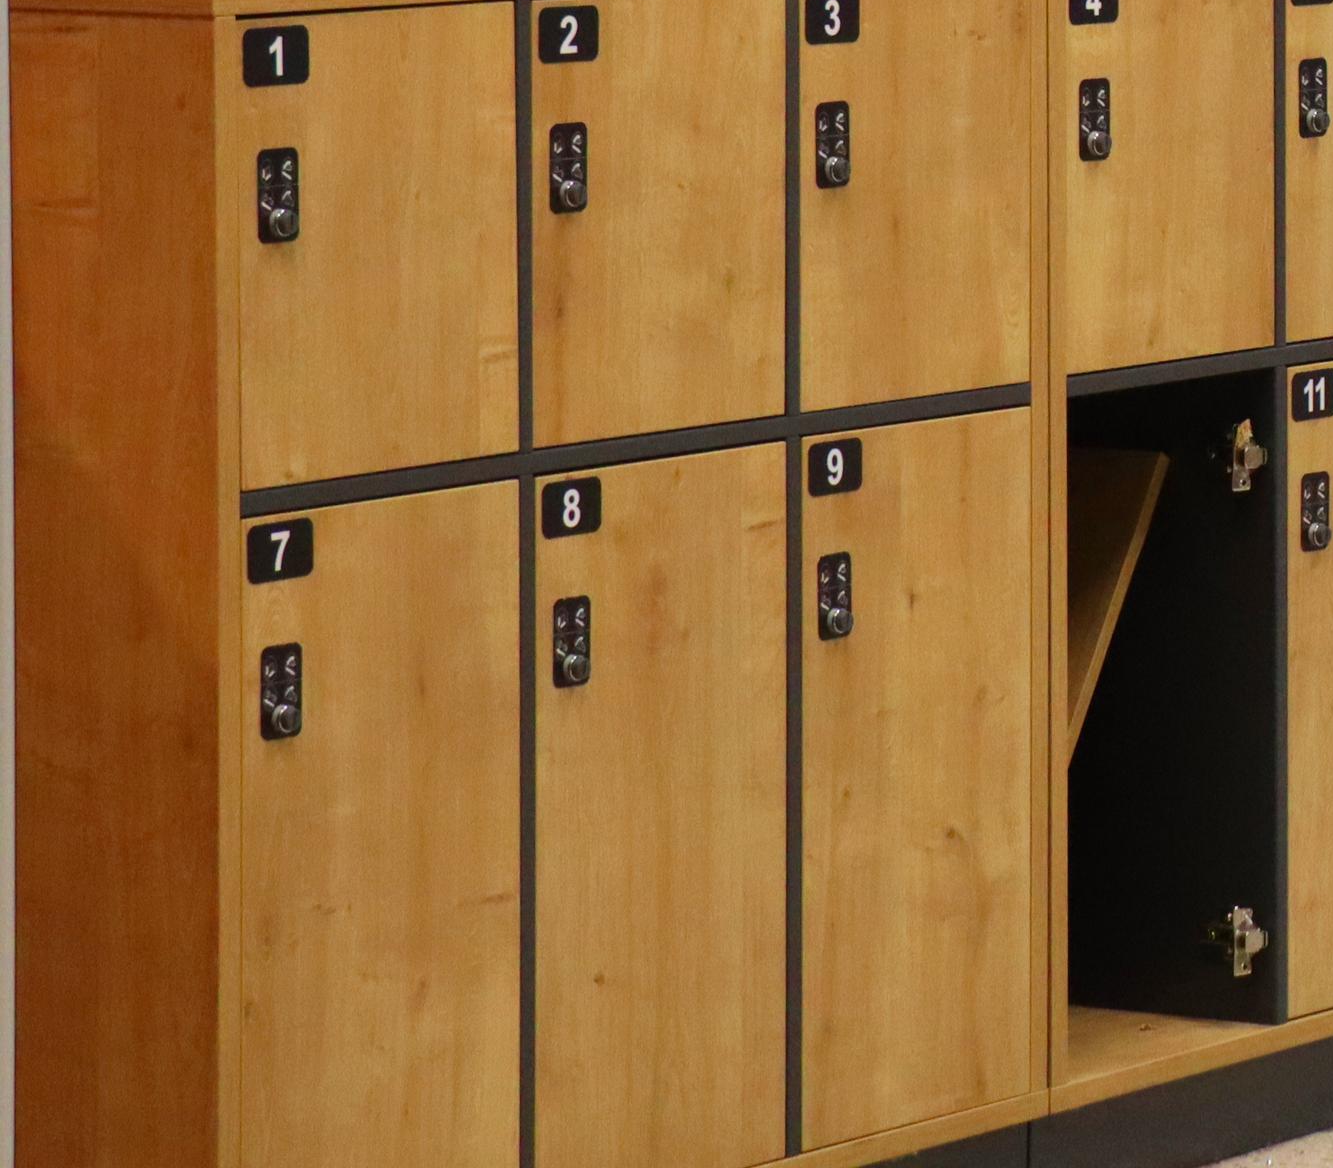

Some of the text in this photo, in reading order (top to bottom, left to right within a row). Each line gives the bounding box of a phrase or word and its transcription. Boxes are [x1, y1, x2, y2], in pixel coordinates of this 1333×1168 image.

[559, 15, 578, 55] 2
[823, 0, 841, 36] 3
[267, 36, 285, 76] 1
[1304, 377, 1326, 412] 11
[825, 448, 843, 486] 9
[562, 488, 581, 528] 8
[270, 531, 291, 571] 7
